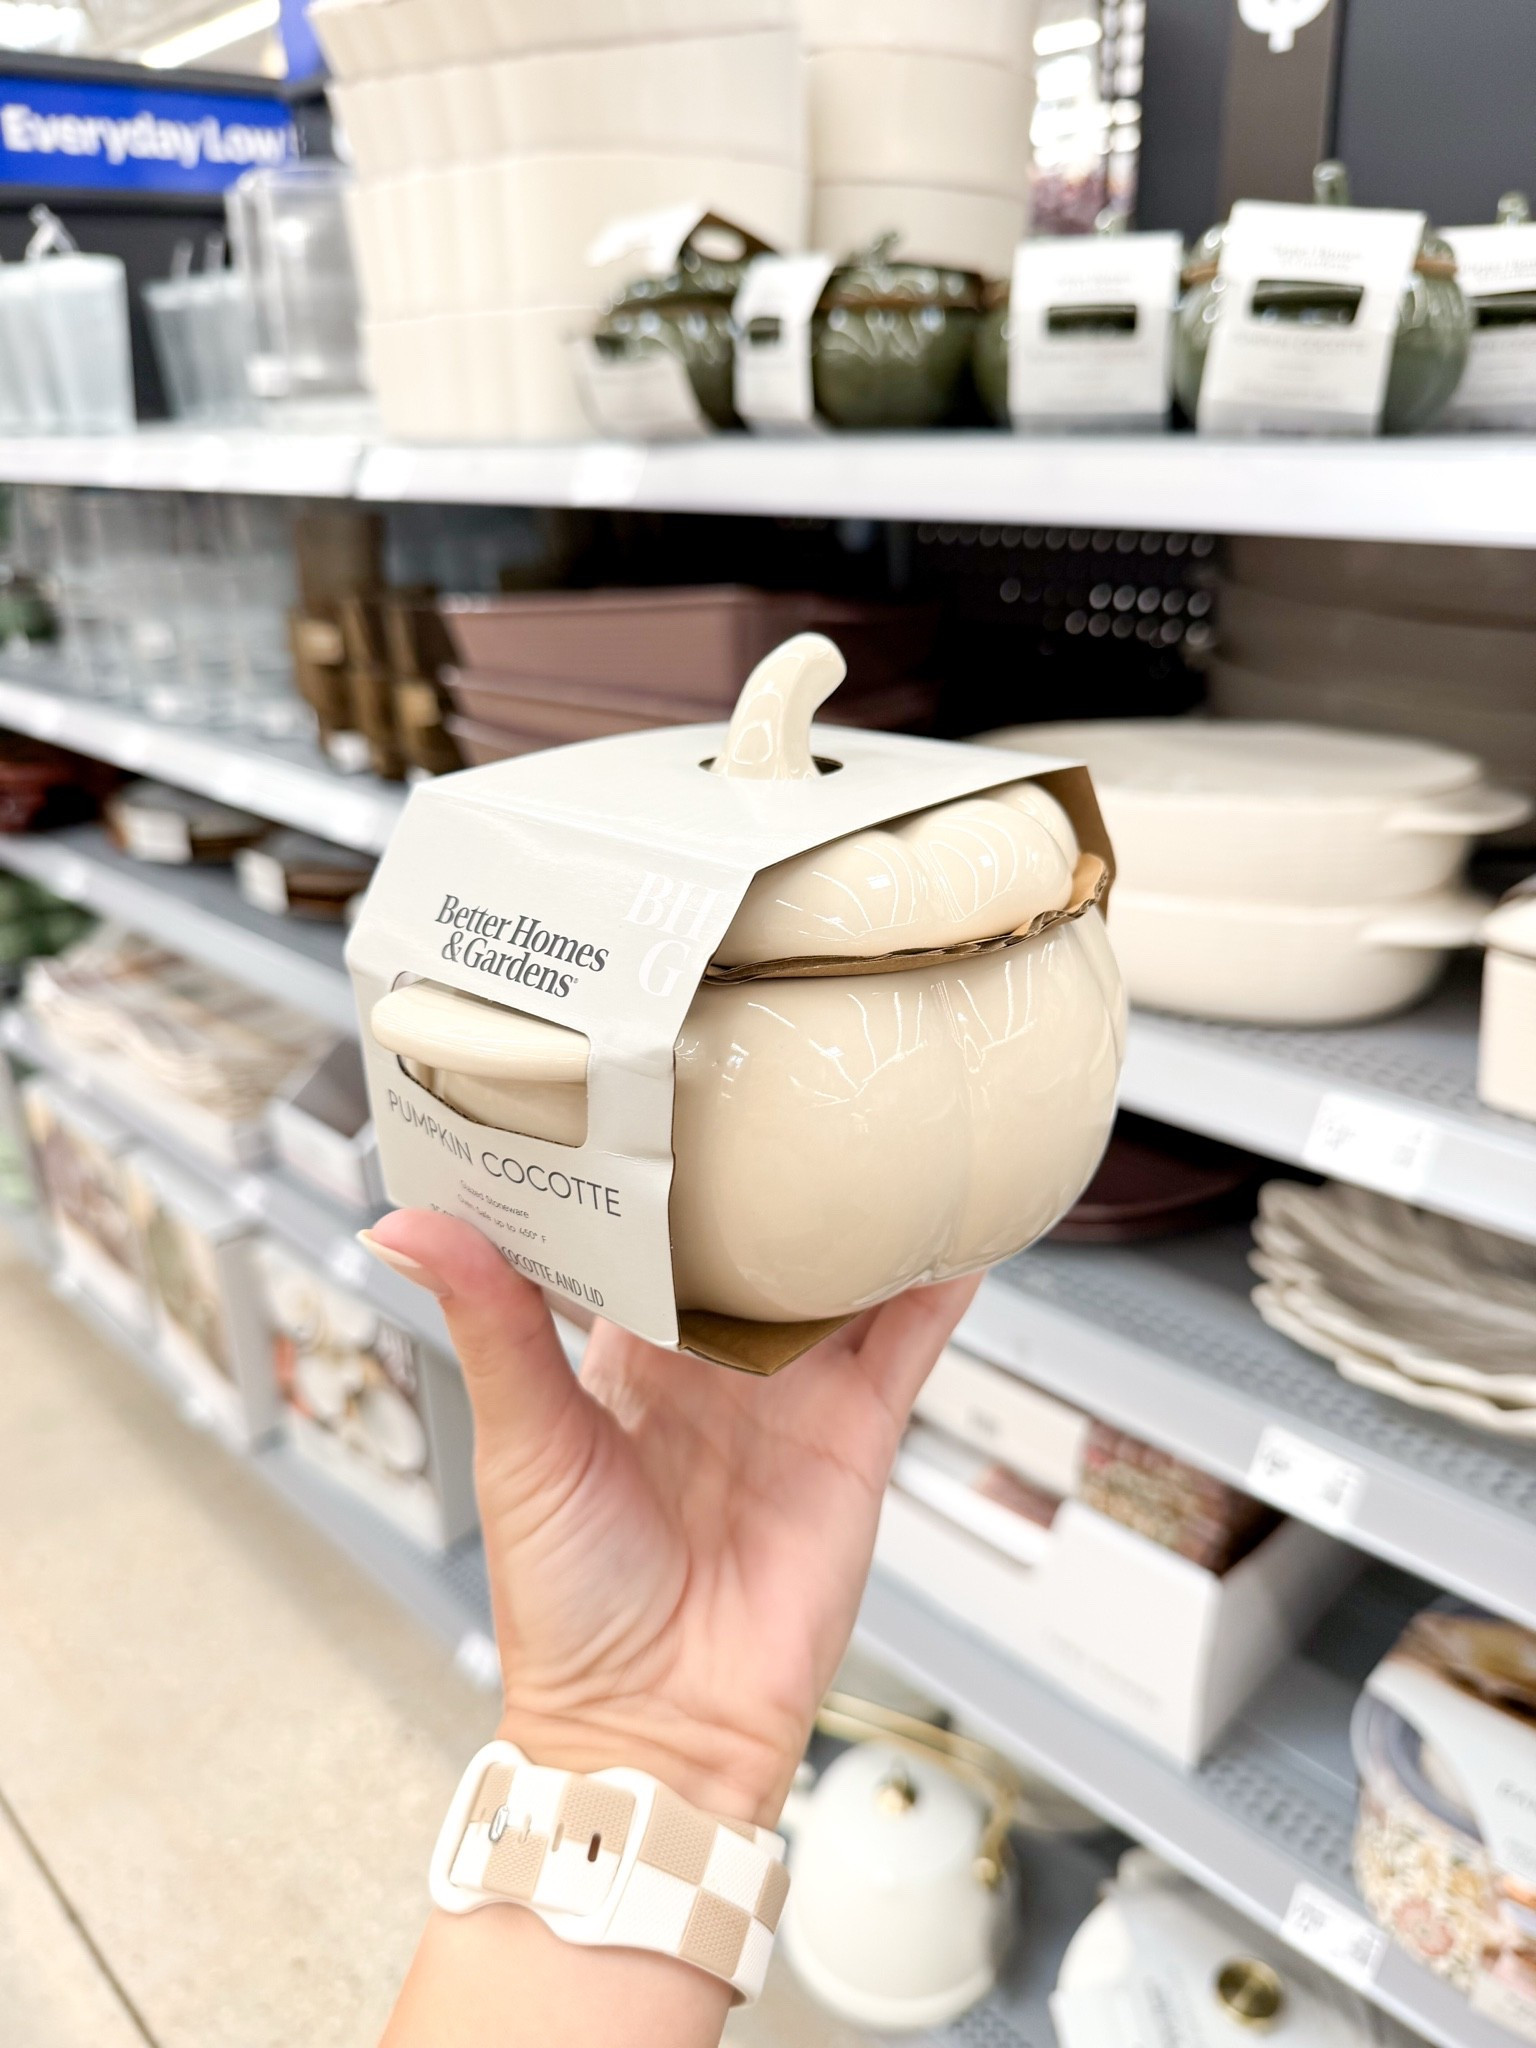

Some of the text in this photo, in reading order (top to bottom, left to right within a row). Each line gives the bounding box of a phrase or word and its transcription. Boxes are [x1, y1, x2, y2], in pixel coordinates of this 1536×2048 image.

[2, 103, 287, 169] Everyday Low
[434, 894, 610, 972] Better Homes
[387, 1088, 622, 1217] PUMPKIN COCOTTE
[485, 1195, 529, 1219] Stoneware
[501, 1246, 605, 1308] COCOTTE AND LID
